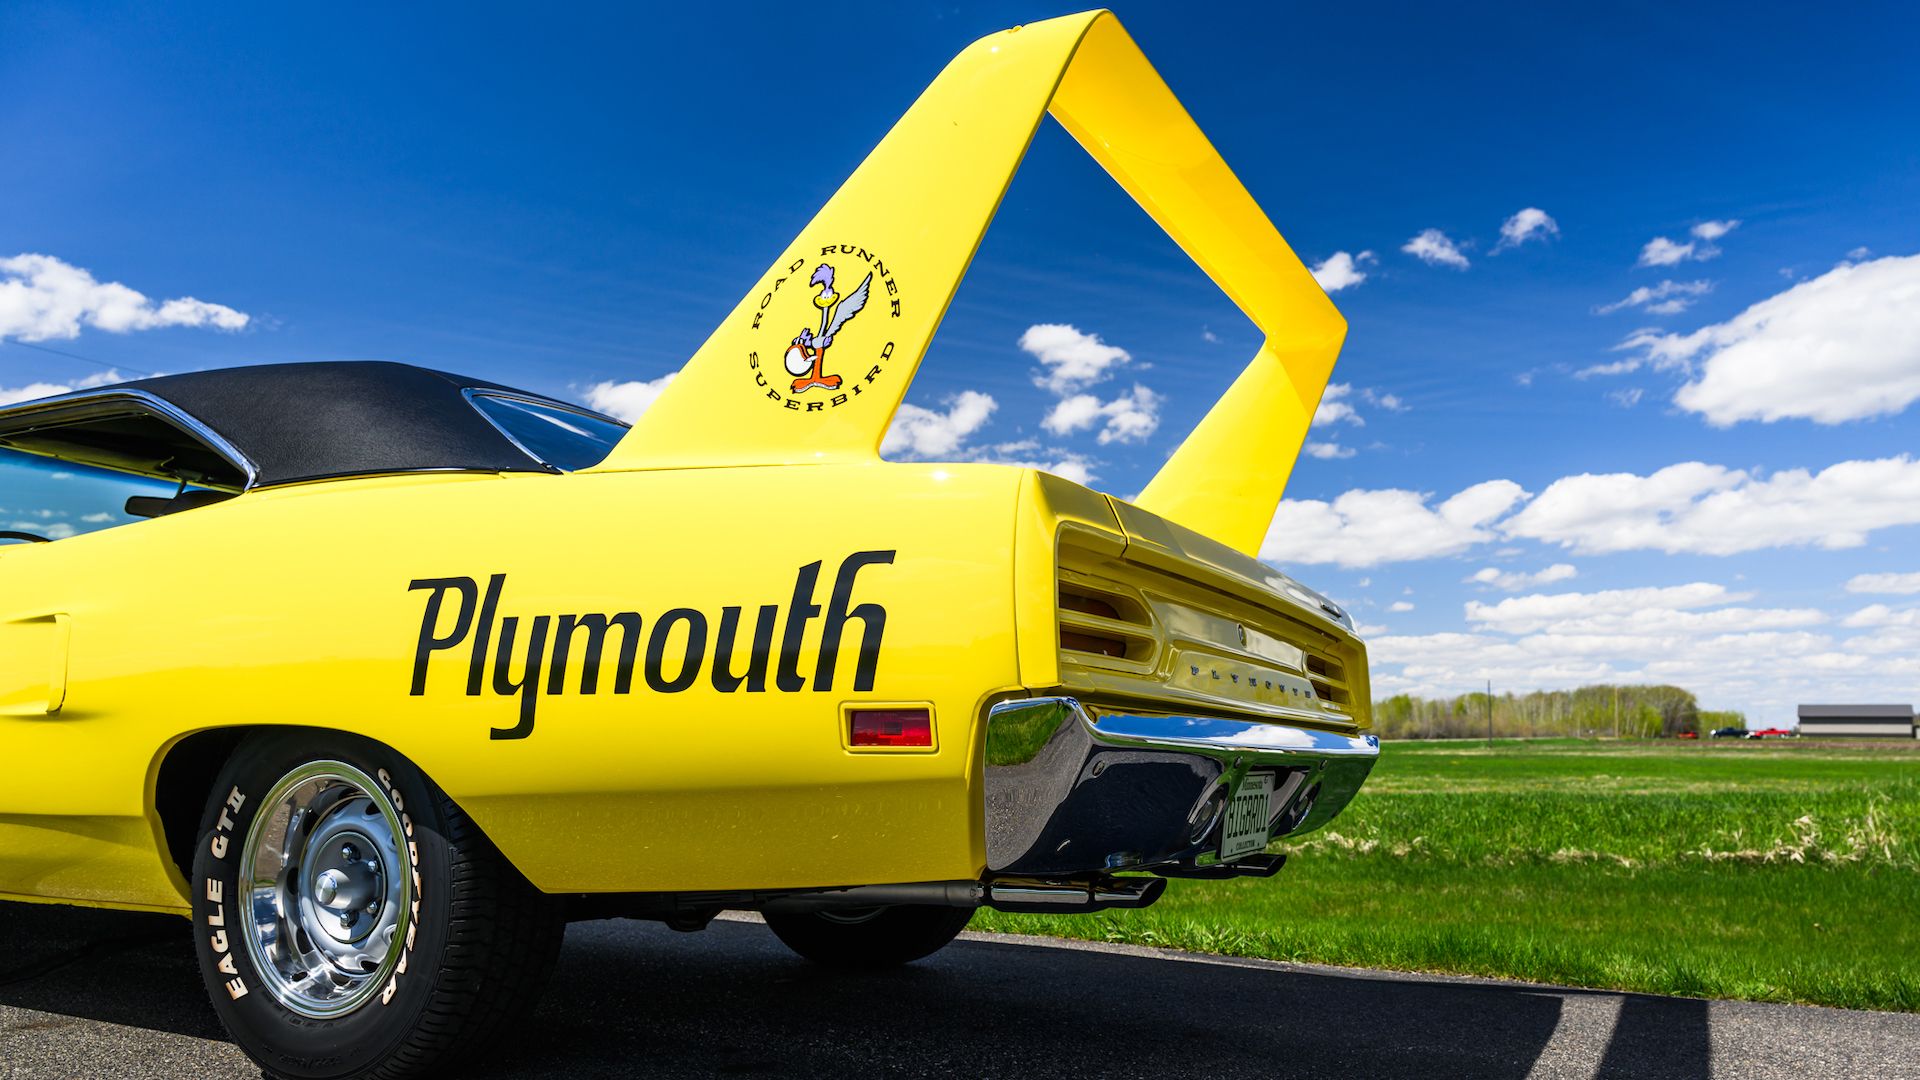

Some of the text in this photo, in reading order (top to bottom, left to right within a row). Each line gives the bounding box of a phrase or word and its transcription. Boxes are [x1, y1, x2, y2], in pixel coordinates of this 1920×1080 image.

[752, 245, 901, 330] ROAD RUNNER
[749, 342, 895, 412] SUPERBIRD
[407, 550, 897, 741] Plymouth
[206, 877, 249, 1001] EAGLE
[377, 767, 422, 1006] GOODYEAR
